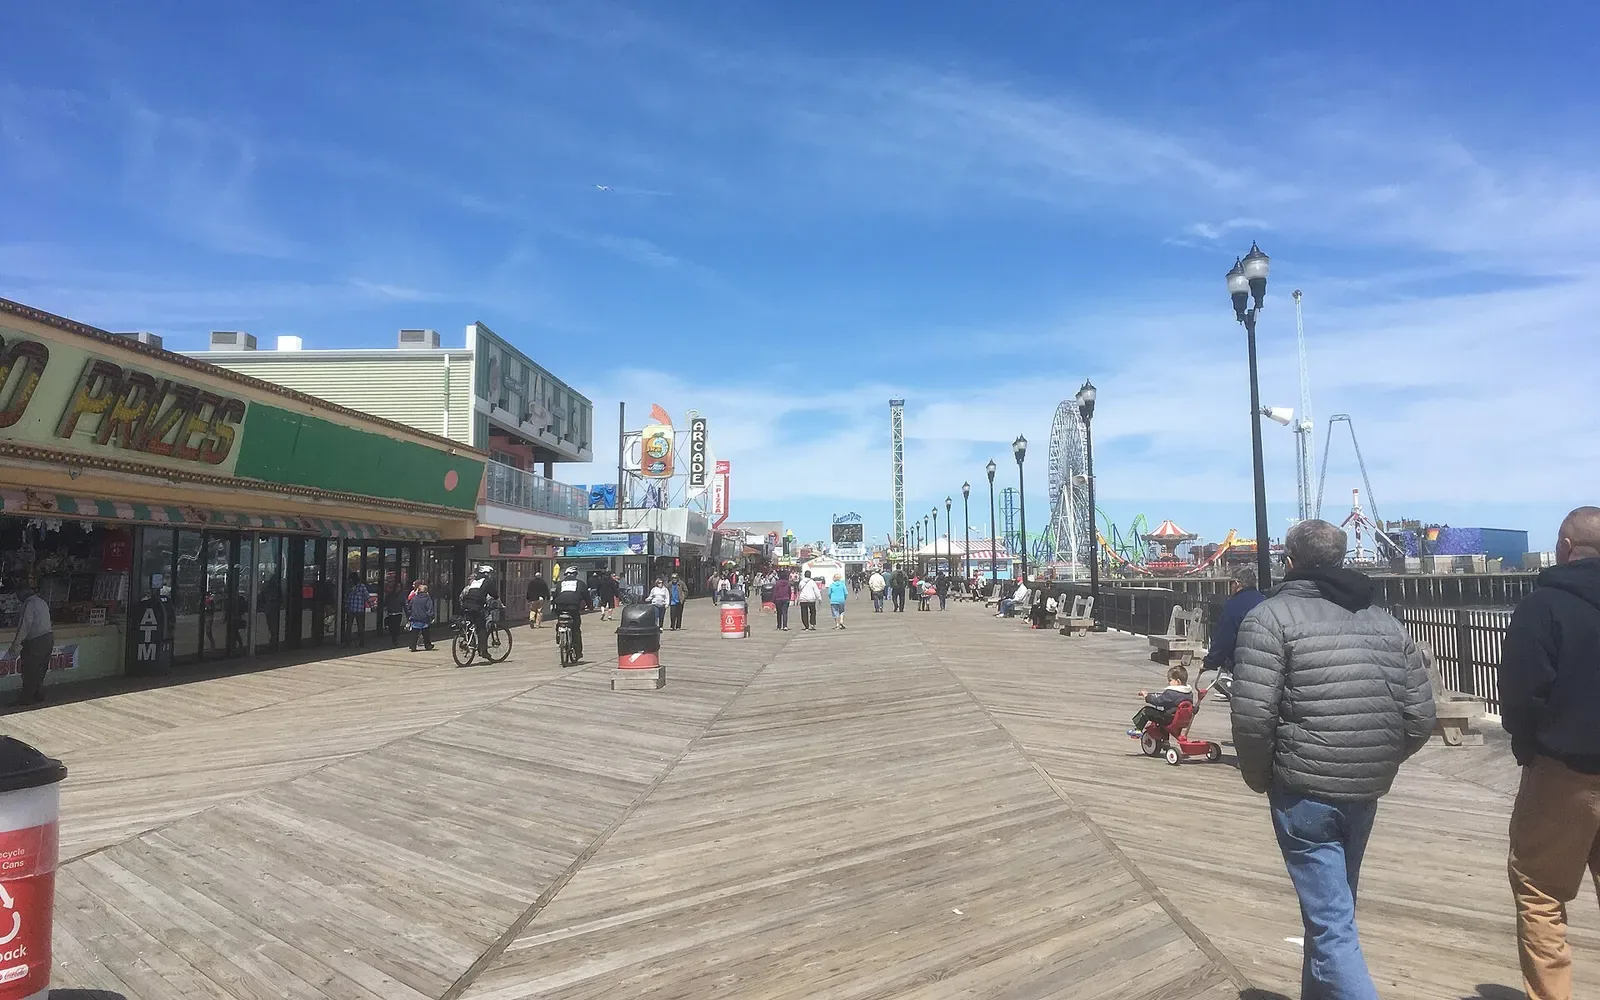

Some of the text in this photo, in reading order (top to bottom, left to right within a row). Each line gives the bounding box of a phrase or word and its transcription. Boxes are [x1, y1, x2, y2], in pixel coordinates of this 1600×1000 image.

[0, 336, 246, 465] O PRIZES
[692, 421, 704, 484] ARCADE
[138, 608, 157, 660] ATM
[0, 848, 24, 859] ecycle
[2, 860, 24, 870] Cans
